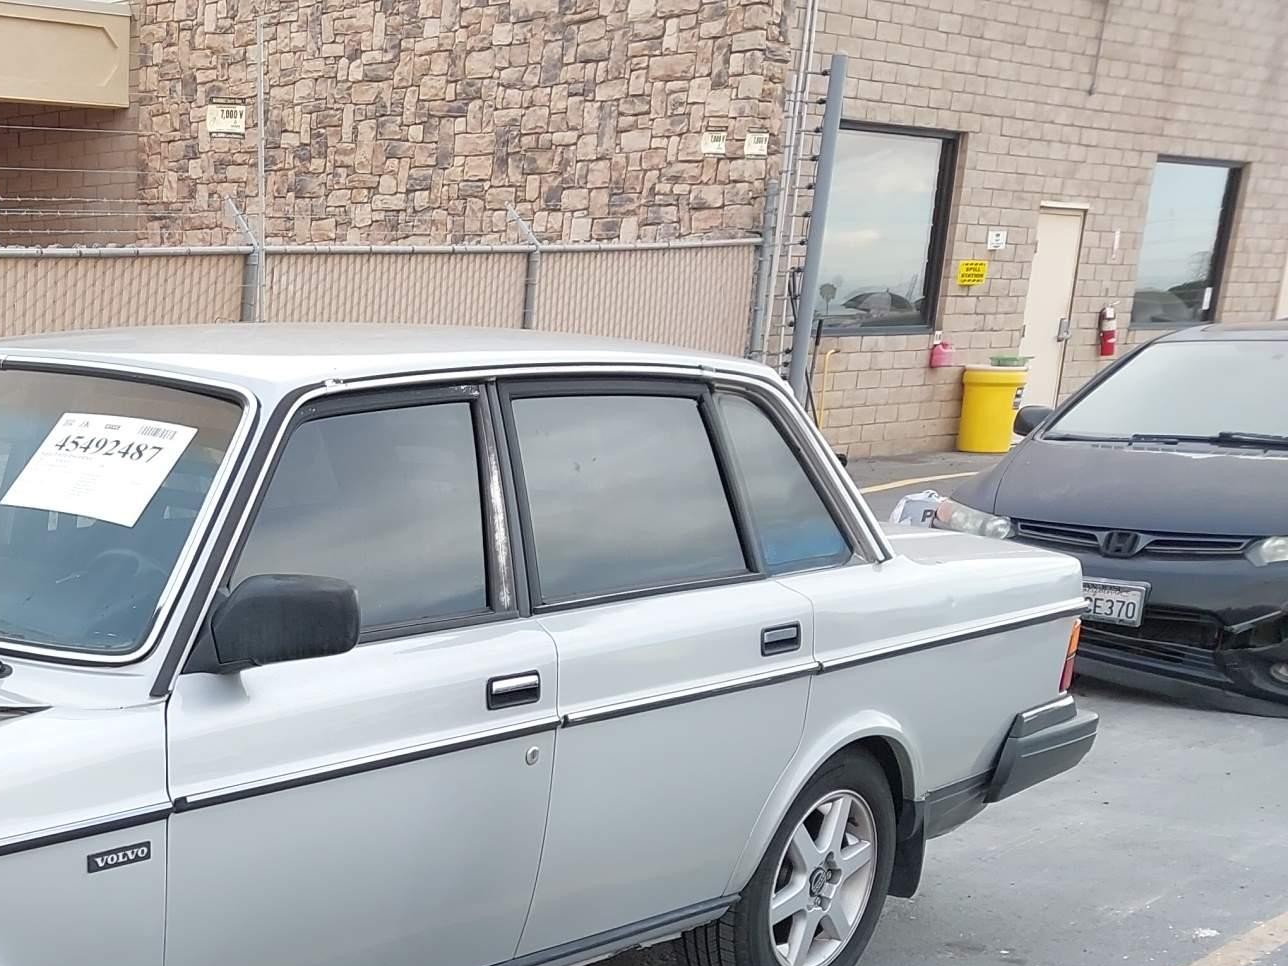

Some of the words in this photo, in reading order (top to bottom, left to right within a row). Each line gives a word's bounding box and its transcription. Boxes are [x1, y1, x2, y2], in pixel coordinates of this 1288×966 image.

[220, 109, 238, 120] 7,000
[239, 109, 244, 119] V
[54, 434, 165, 464] 45492487
[95, 846, 148, 867] VOLVO
